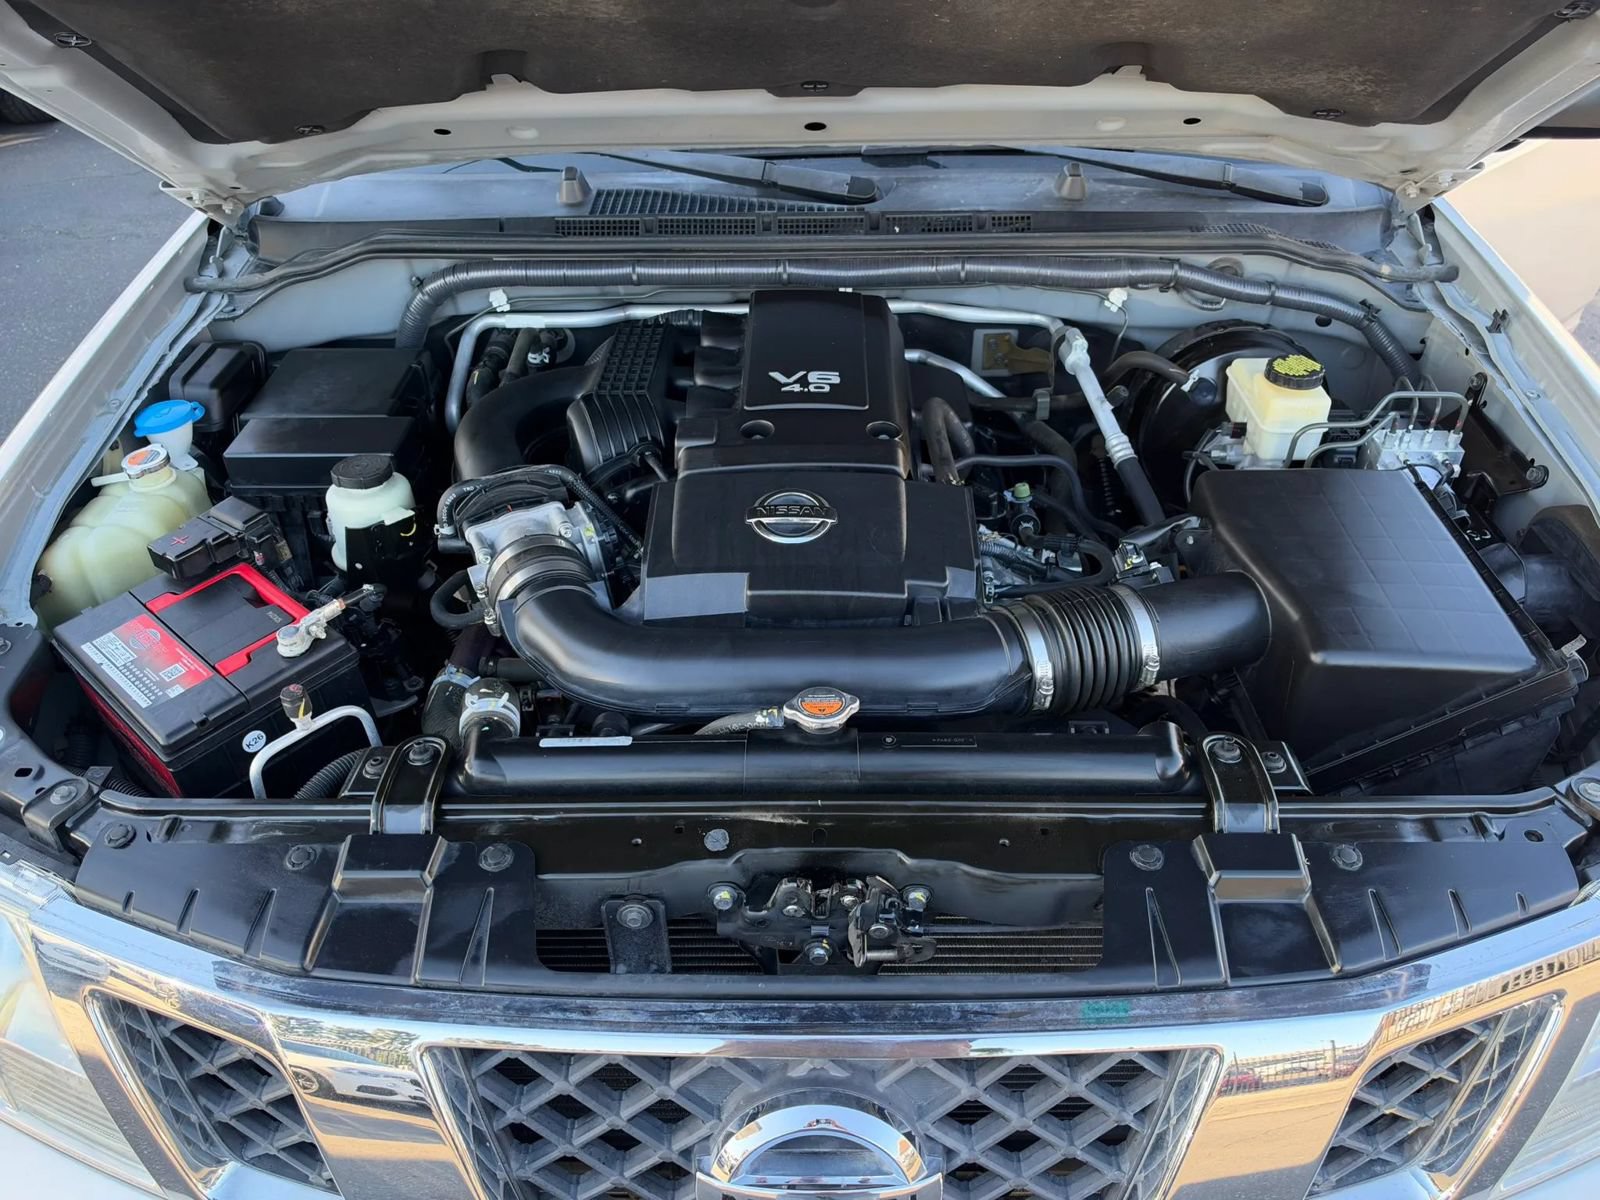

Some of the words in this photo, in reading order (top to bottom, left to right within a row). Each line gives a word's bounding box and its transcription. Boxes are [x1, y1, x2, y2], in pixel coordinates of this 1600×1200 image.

[768, 371, 841, 384] V6
[781, 384, 831, 392] 4.0
[756, 505, 827, 516] NISSAN
[245, 733, 264, 750] K26
